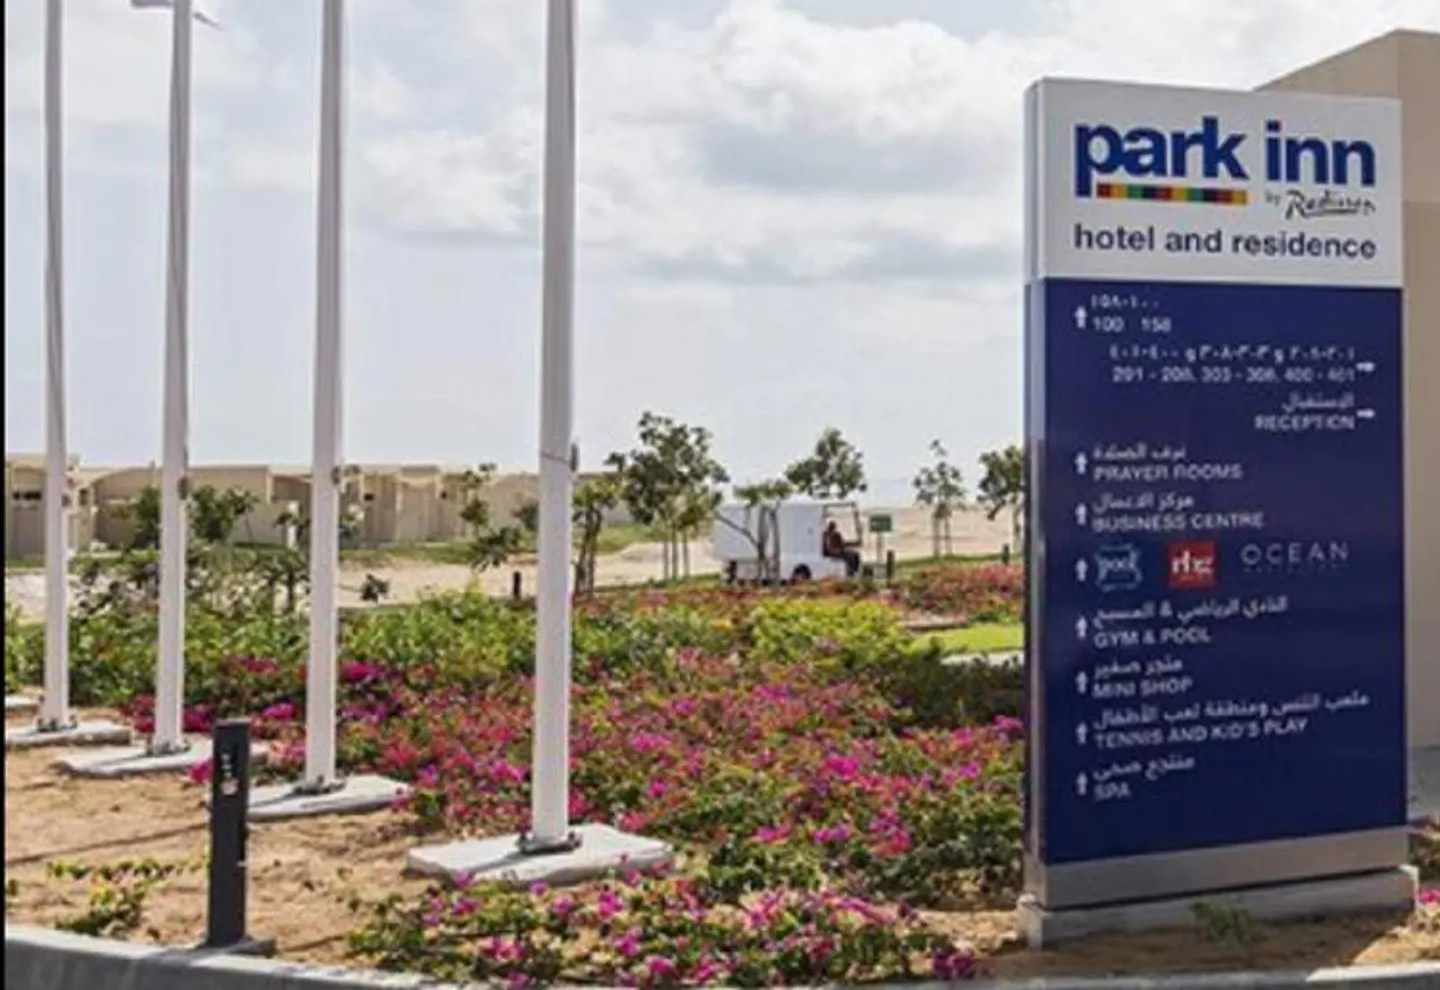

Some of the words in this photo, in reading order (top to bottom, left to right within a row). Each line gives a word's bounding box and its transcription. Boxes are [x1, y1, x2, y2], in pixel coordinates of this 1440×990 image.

[1074, 116, 1250, 198] park
[1264, 119, 1376, 187] inn
[1264, 191, 1281, 205] by
[1284, 190, 1376, 220] Radisson
[1074, 222, 1155, 251] hotel
[1164, 227, 1222, 255] and
[1231, 230, 1376, 259] residence
[1092, 316, 1125, 332] 100
[1254, 414, 1355, 431] RECEPTION
[1093, 465, 1169, 481] PRAYER
[1173, 463, 1244, 480] ROOMS
[1091, 514, 1186, 533] BUSINESS
[1190, 512, 1264, 530] CENTRE
[1240, 542, 1349, 565] OCEAN
[1094, 630, 1140, 649] GYM
[1160, 627, 1212, 645] POOL
[1092, 681, 1136, 698] MINI
[1140, 678, 1193, 697] SHOP
[1094, 727, 1163, 749] TENNIS
[1167, 724, 1208, 743] AND
[1263, 718, 1309, 736] PLAY
[1093, 782, 1132, 802] SPA
